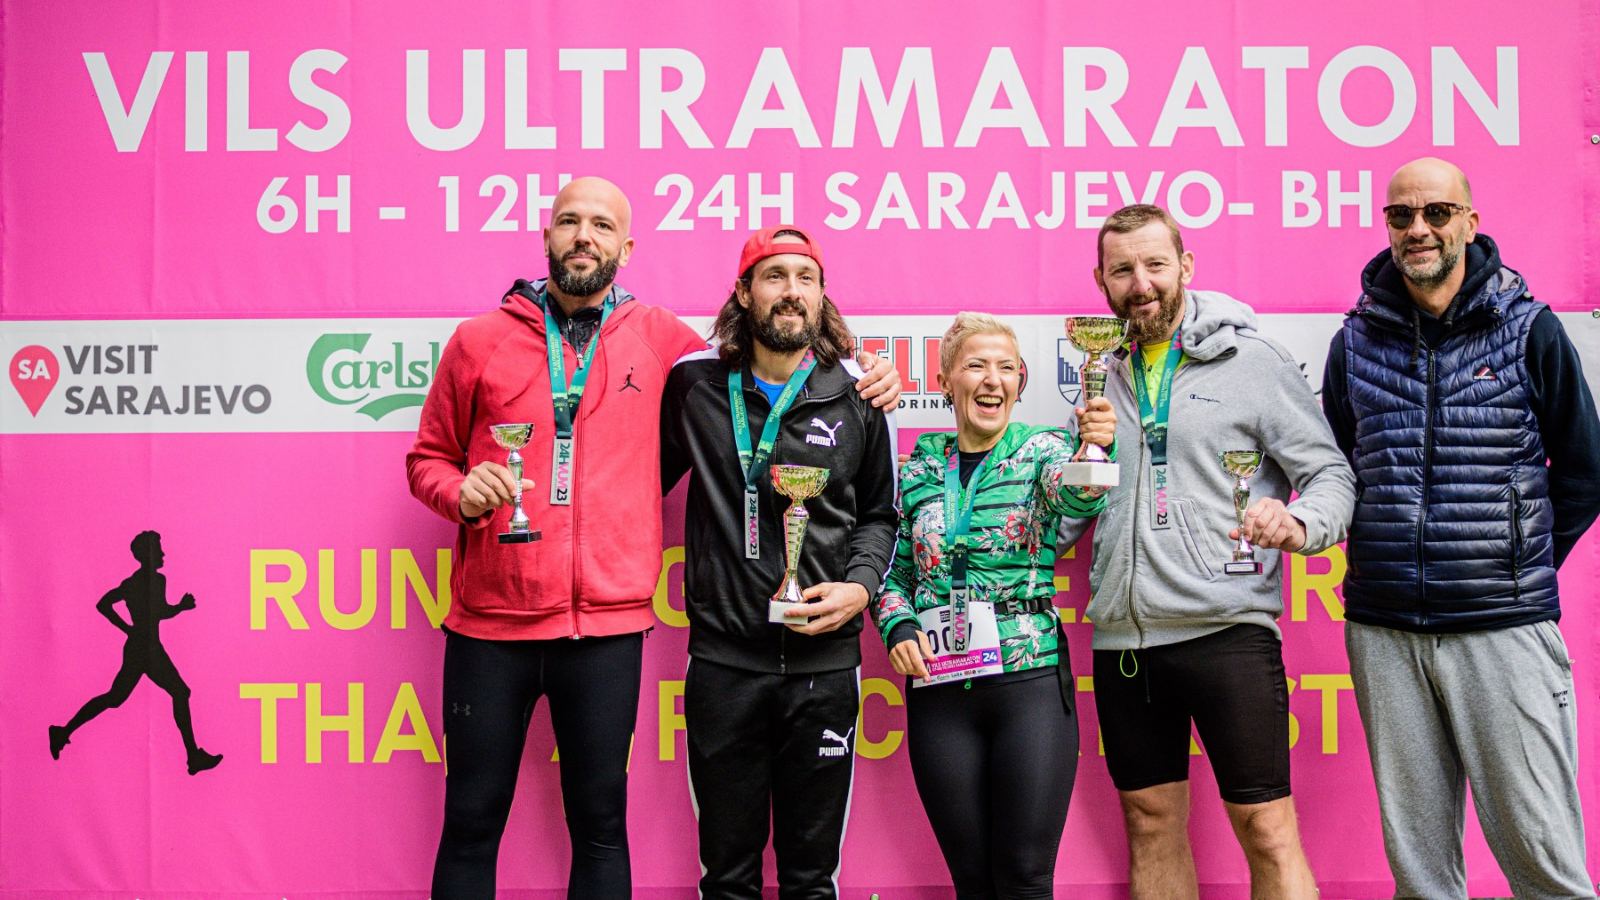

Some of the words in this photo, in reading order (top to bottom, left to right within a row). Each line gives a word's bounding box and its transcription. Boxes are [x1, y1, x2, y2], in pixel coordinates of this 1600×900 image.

[82, 48, 352, 153] VILS
[405, 45, 1521, 150] ULTRAMARATON
[256, 174, 351, 234] 6H
[438, 173, 572, 232] 12H
[654, 172, 795, 231] 24H
[1281, 170, 1373, 228] BH
[17, 358, 51, 380] SA
[63, 344, 159, 375] VISIT
[64, 384, 272, 416] SARAJEVO
[805, 434, 831, 447] PUMA
[818, 746, 846, 757] PUMA
